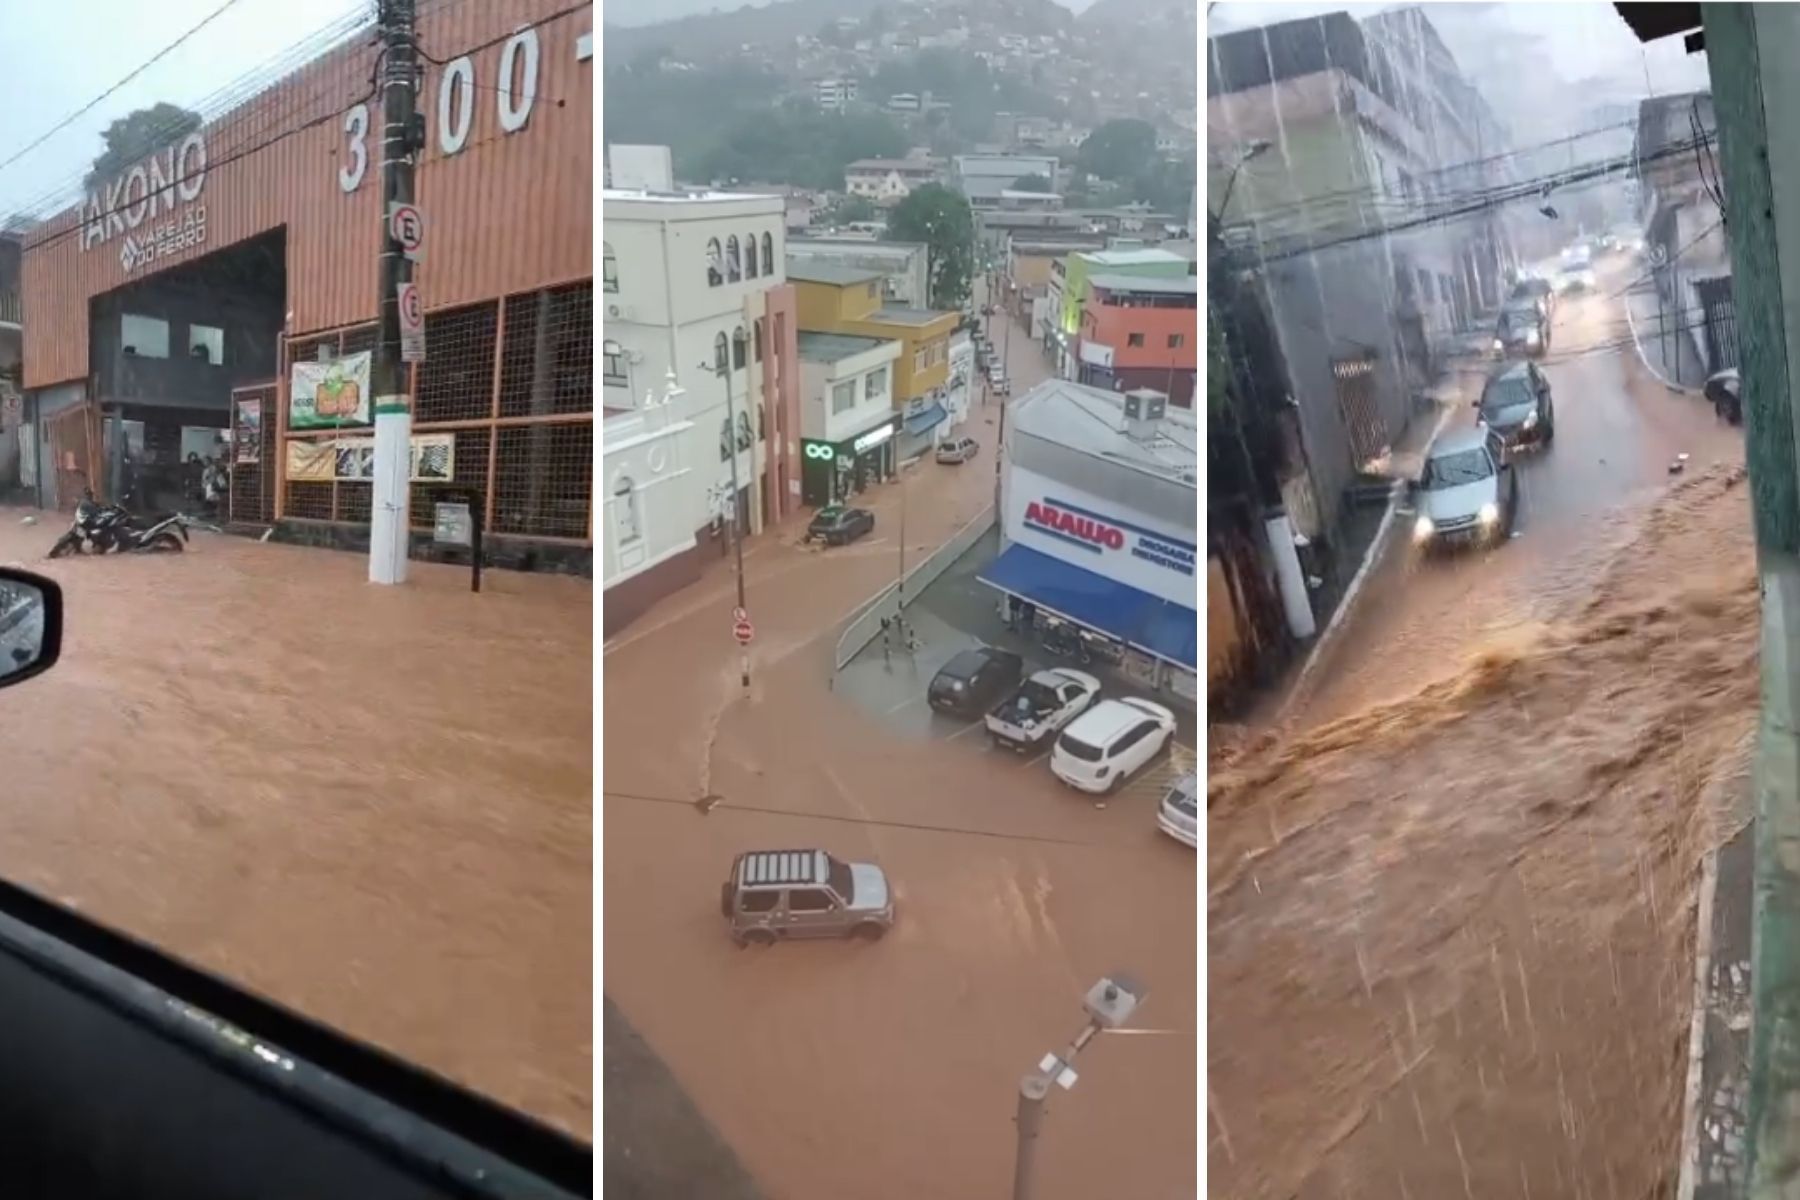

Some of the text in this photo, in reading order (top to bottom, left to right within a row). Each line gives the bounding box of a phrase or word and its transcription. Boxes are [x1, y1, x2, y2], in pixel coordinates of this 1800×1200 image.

[157, 226, 206, 255] FERRO
[403, 216, 417, 241] E
[1024, 502, 1124, 551] ARAUJO
